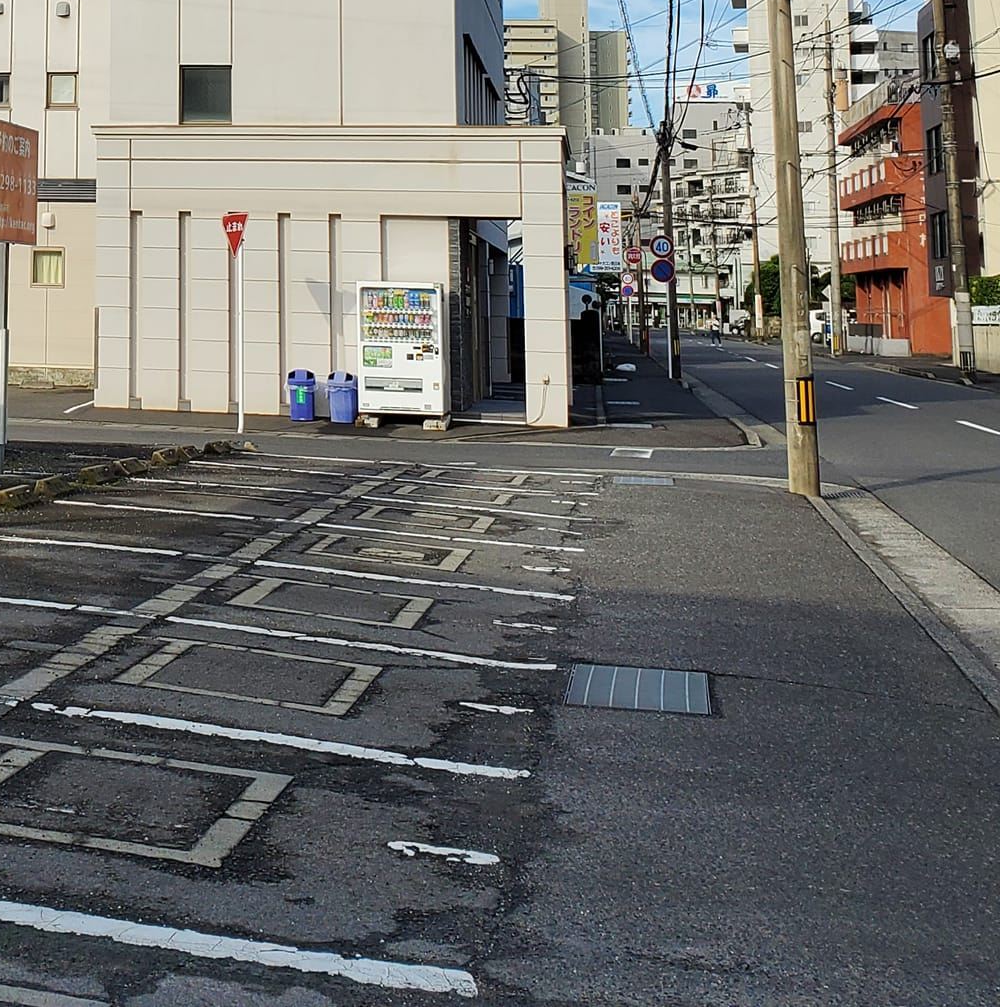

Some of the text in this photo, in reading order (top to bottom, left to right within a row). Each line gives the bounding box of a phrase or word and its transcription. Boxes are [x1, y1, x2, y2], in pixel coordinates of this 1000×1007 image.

[582, 195, 595, 229] コイン
[226, 221, 243, 233] 止まれ
[599, 222, 610, 246] 安い
[655, 241, 669, 252] 40
